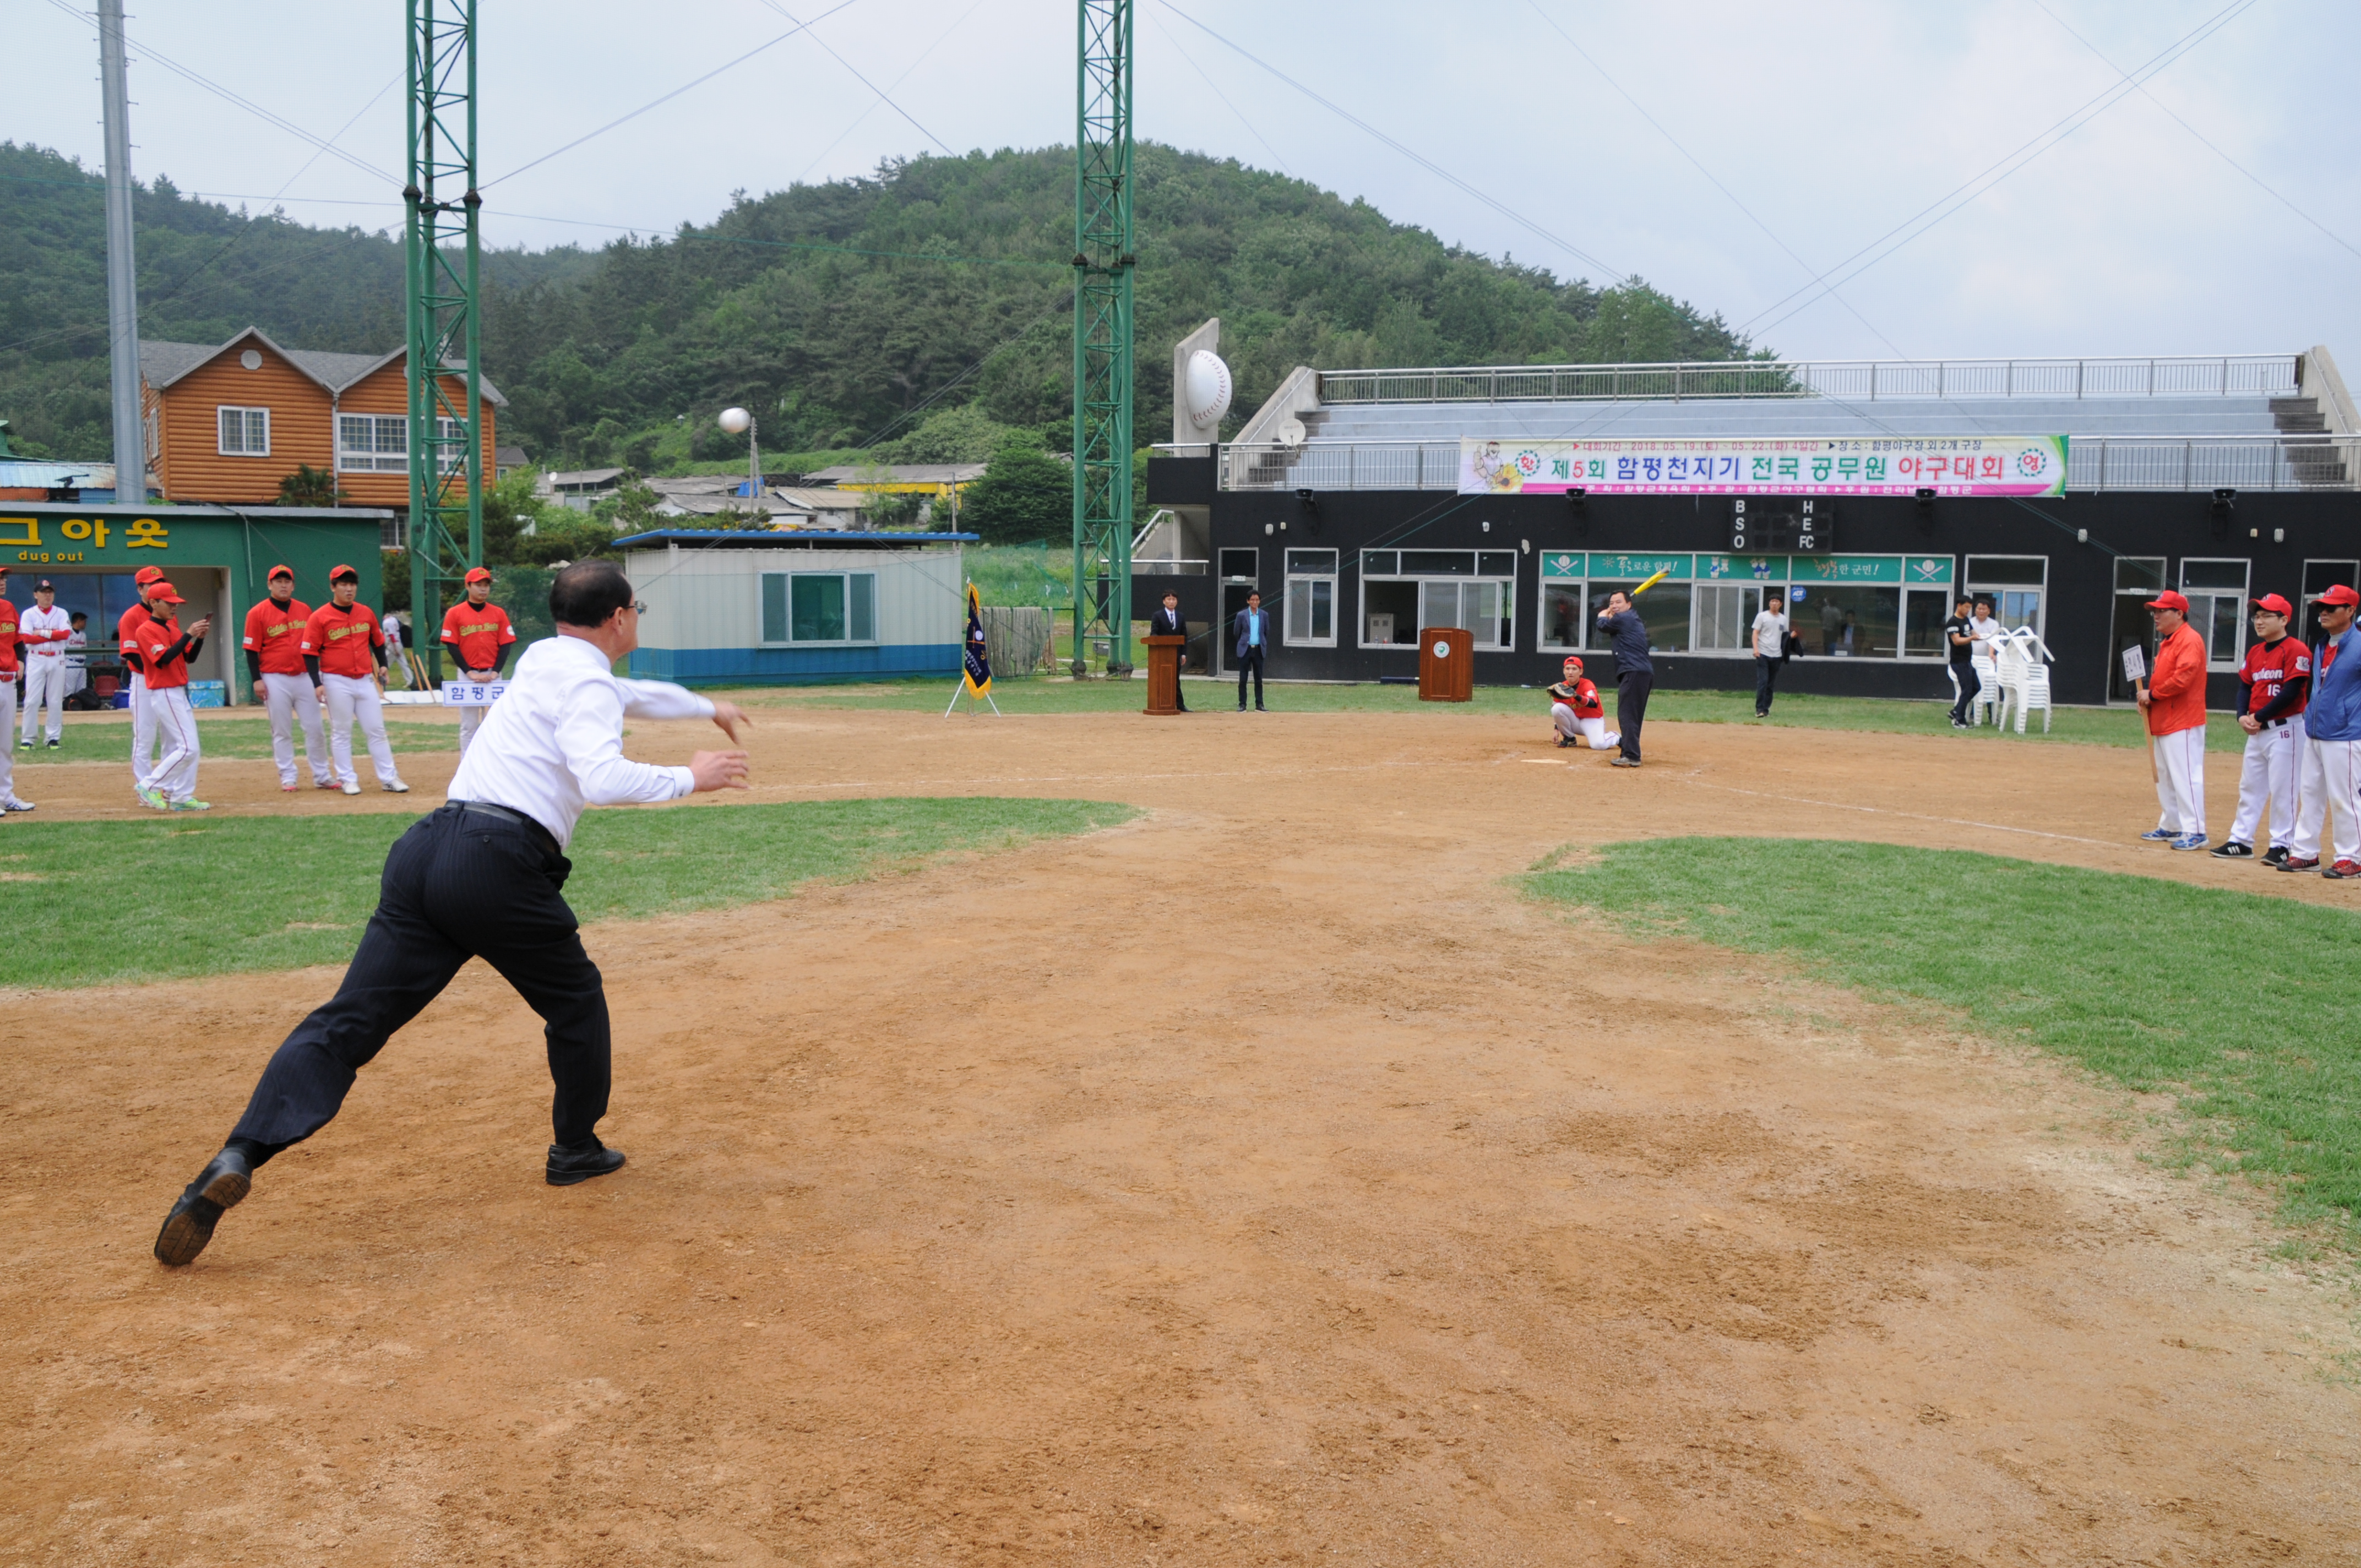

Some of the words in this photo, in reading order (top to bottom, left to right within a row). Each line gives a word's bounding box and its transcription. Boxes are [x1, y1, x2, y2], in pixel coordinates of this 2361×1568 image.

[1584, 442, 1621, 451] 대회기간
[1792, 441, 1819, 451] 4일간
[1873, 440, 1923, 451] 함평야구장
[1927, 440, 1937, 450] 외
[1941, 440, 1957, 450] 2개
[1961, 440, 1982, 450] 구장
[1521, 456, 1535, 471] 환
[1552, 459, 1605, 480] 제5회
[1618, 456, 1739, 481] 함평천지기
[1752, 458, 1799, 481] 전국
[1811, 456, 1886, 481] 공무원
[1898, 456, 2004, 481] 야구대회
[2023, 455, 2039, 471] 영
[1736, 499, 1745, 513] B
[1803, 500, 1813, 514] H
[1735, 517, 1745, 531] S
[1803, 518, 1812, 531] E
[1734, 535, 1745, 548] O
[1799, 535, 1814, 548] FC
[18, 551, 49, 562] dug
[57, 551, 83, 561] out
[1852, 564, 1879, 575] 군민!
[2267, 684, 2281, 696] 16
[2280, 730, 2290, 739] 16
